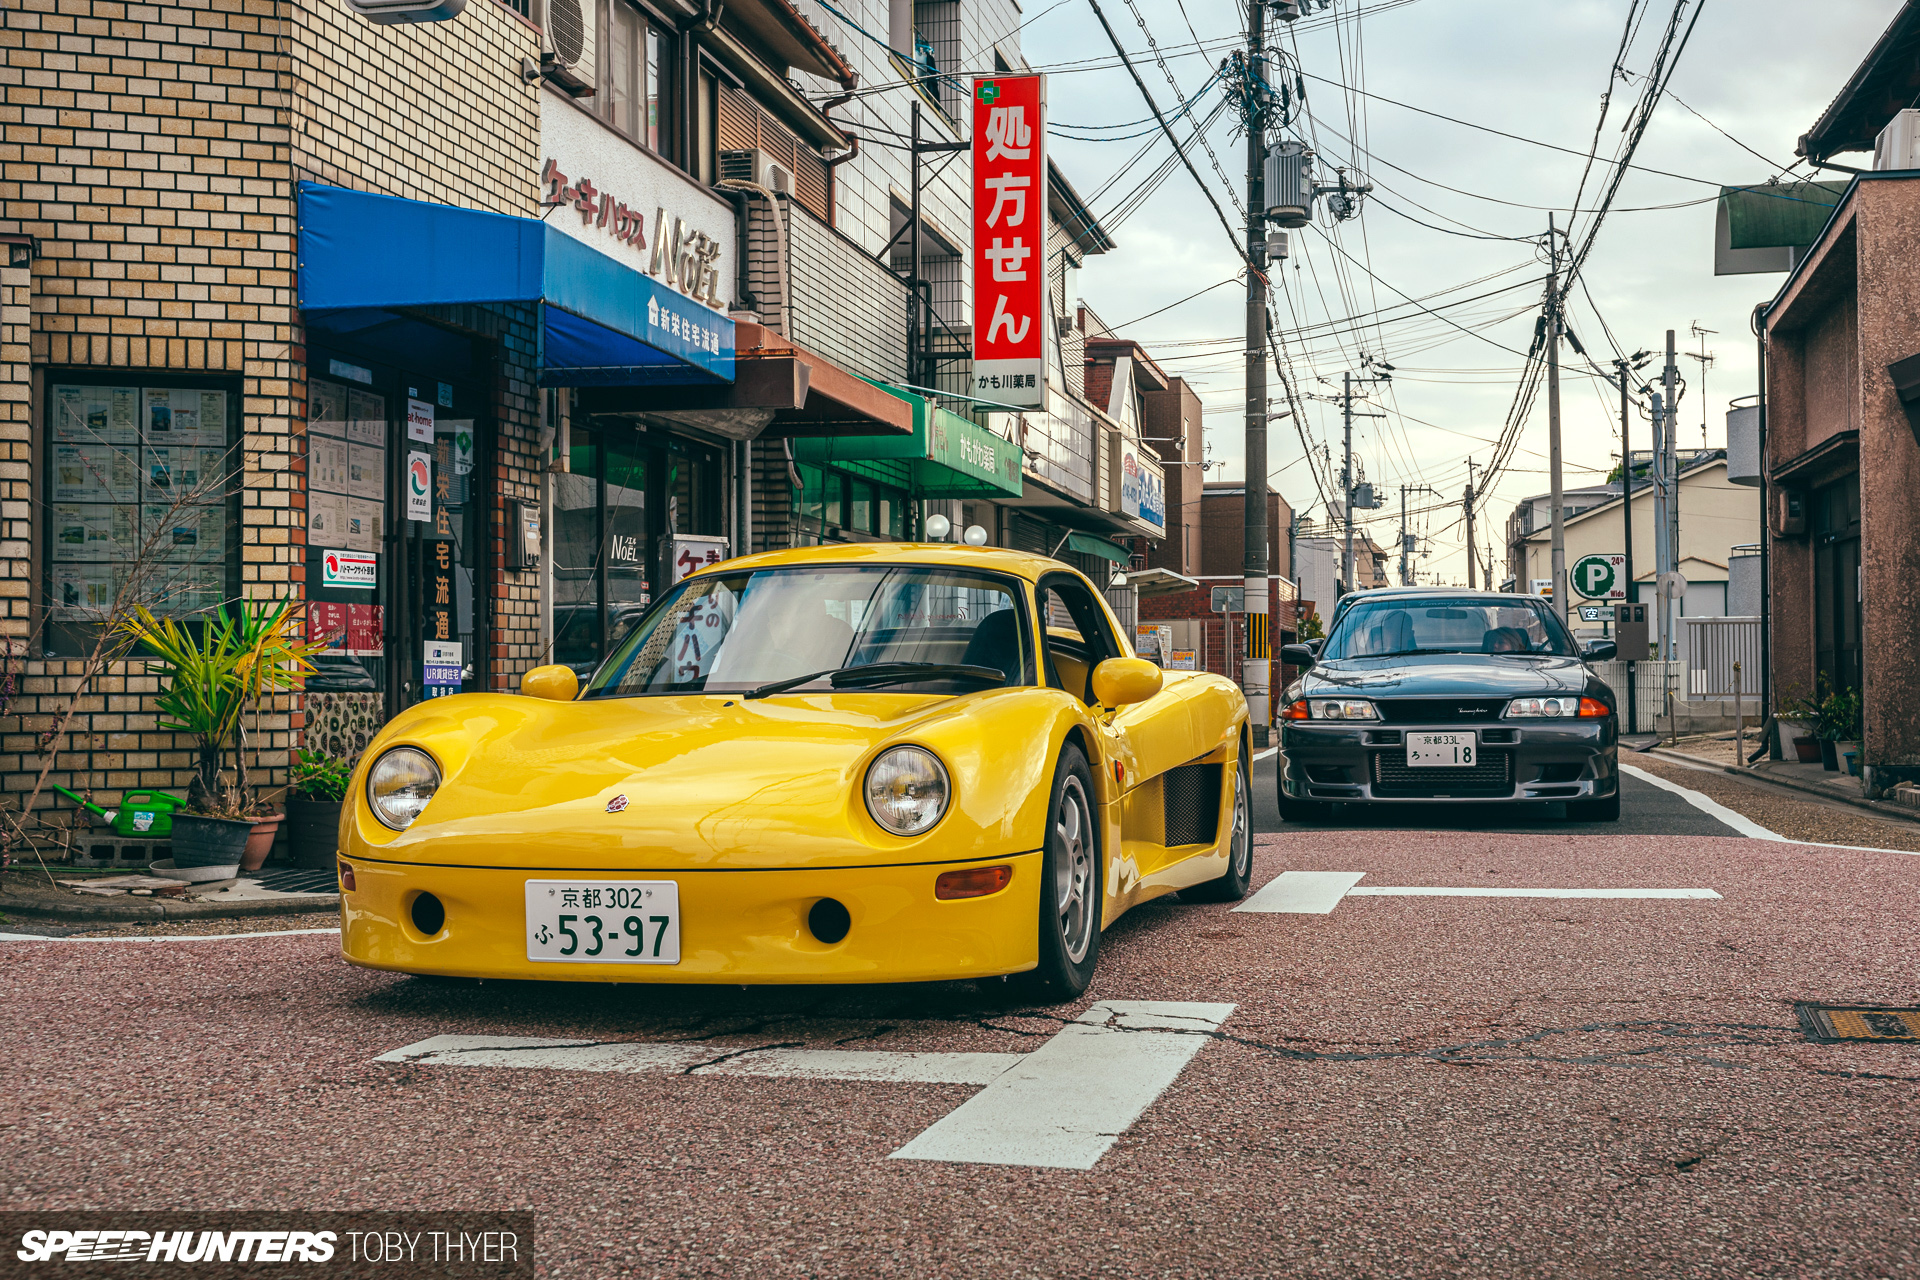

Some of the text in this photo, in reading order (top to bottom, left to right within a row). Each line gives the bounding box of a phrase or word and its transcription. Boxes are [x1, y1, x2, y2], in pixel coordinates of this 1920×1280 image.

[543, 157, 647, 250] ケーキハウス
[985, 105, 1032, 344] 処方せん
[660, 306, 720, 356] 新栄住宅流通
[978, 374, 1036, 389] かも川薬局
[436, 436, 450, 640] 新栄住宅流通
[1586, 564, 1609, 592] P
[1610, 590, 1625, 598] Wide
[1585, 607, 1599, 620] 空
[426, 668, 459, 680] UR賃貸住宅
[1453, 746, 1472, 764] 18
[534, 914, 670, 957] ふ 53-97
